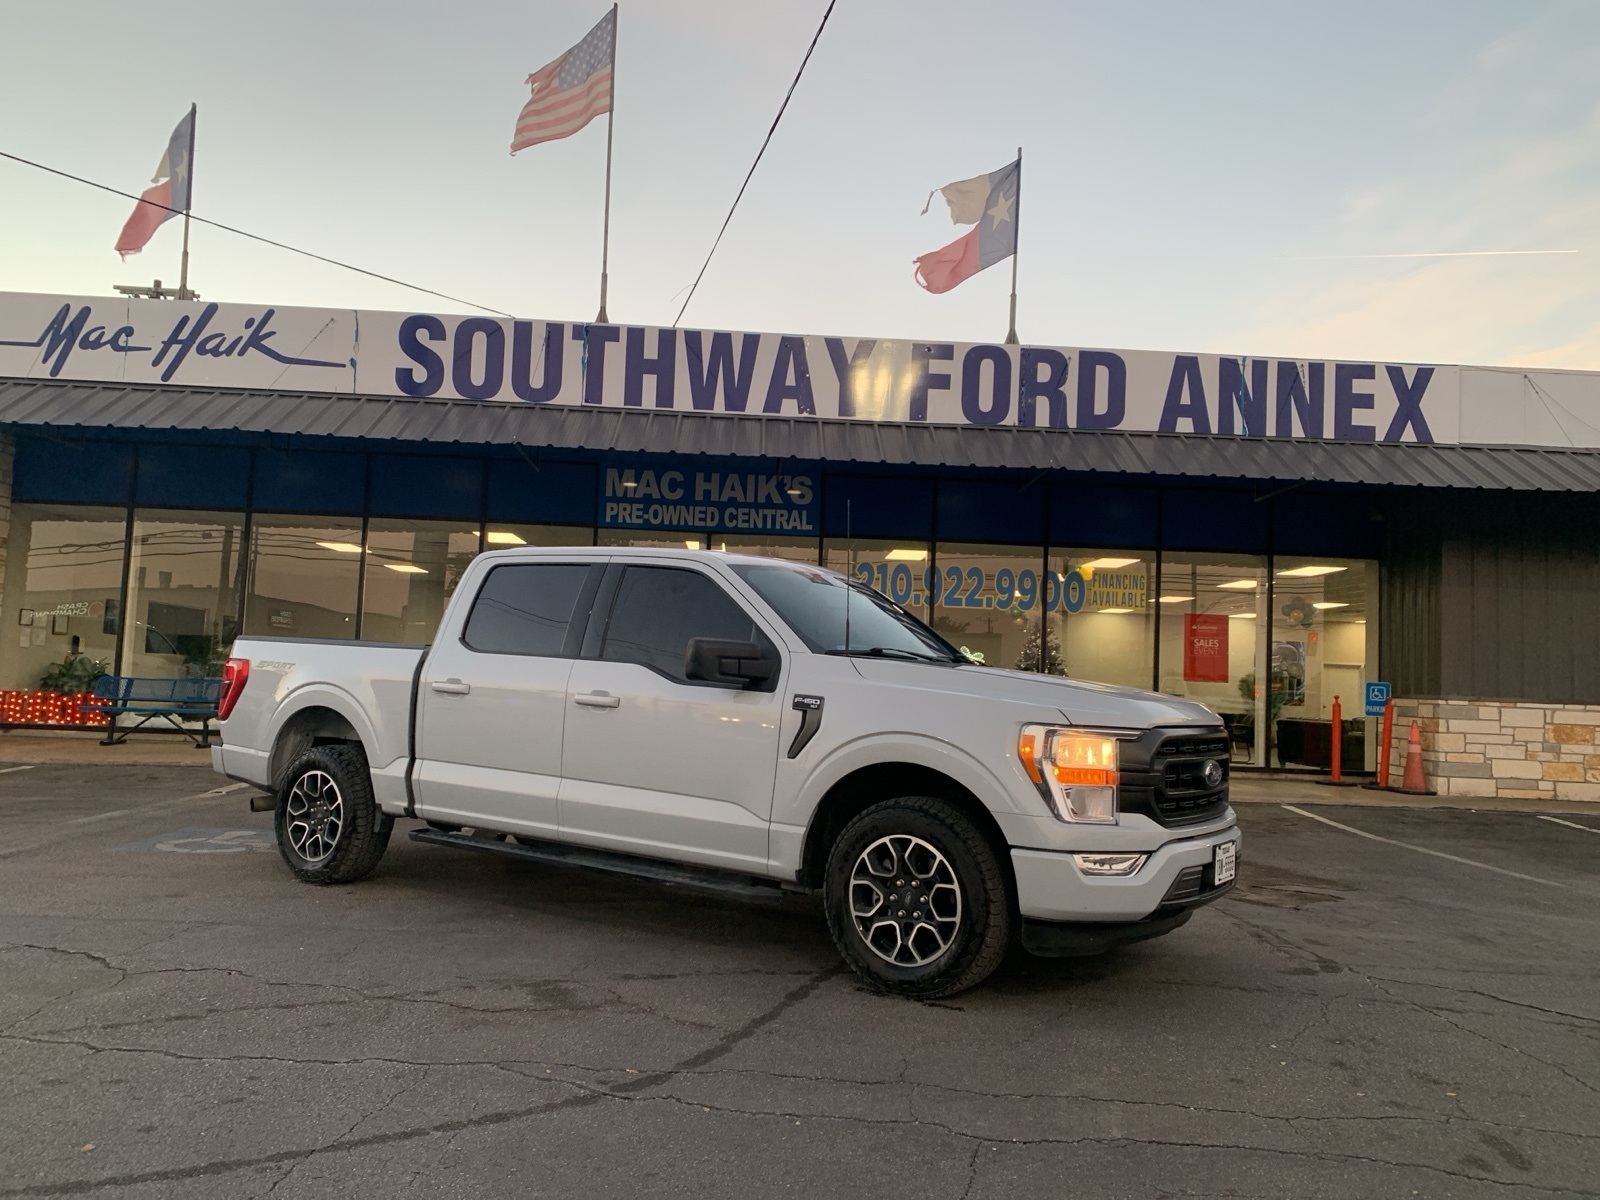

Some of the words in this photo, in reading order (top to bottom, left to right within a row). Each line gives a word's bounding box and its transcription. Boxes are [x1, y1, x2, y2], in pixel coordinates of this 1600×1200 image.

[0, 303, 152, 377] Mac
[151, 302, 346, 382] Haik
[394, 314, 877, 418] SOUTHWAY
[908, 343, 1127, 429] FORD
[1157, 354, 1435, 443] ANNEX
[605, 468, 685, 500] MAC
[694, 472, 814, 506] HAIK'S
[605, 502, 720, 528] PRE-OWNED
[724, 507, 813, 531] CENTRAL
[1091, 572, 1146, 590] FINANCING
[1091, 591, 1146, 609] AVAILABLE
[1193, 638, 1219, 648] SALES
[1193, 647, 1218, 655] EVENT
[256, 660, 296, 670] SPORT
[1366, 705, 1385, 713] PARKI
